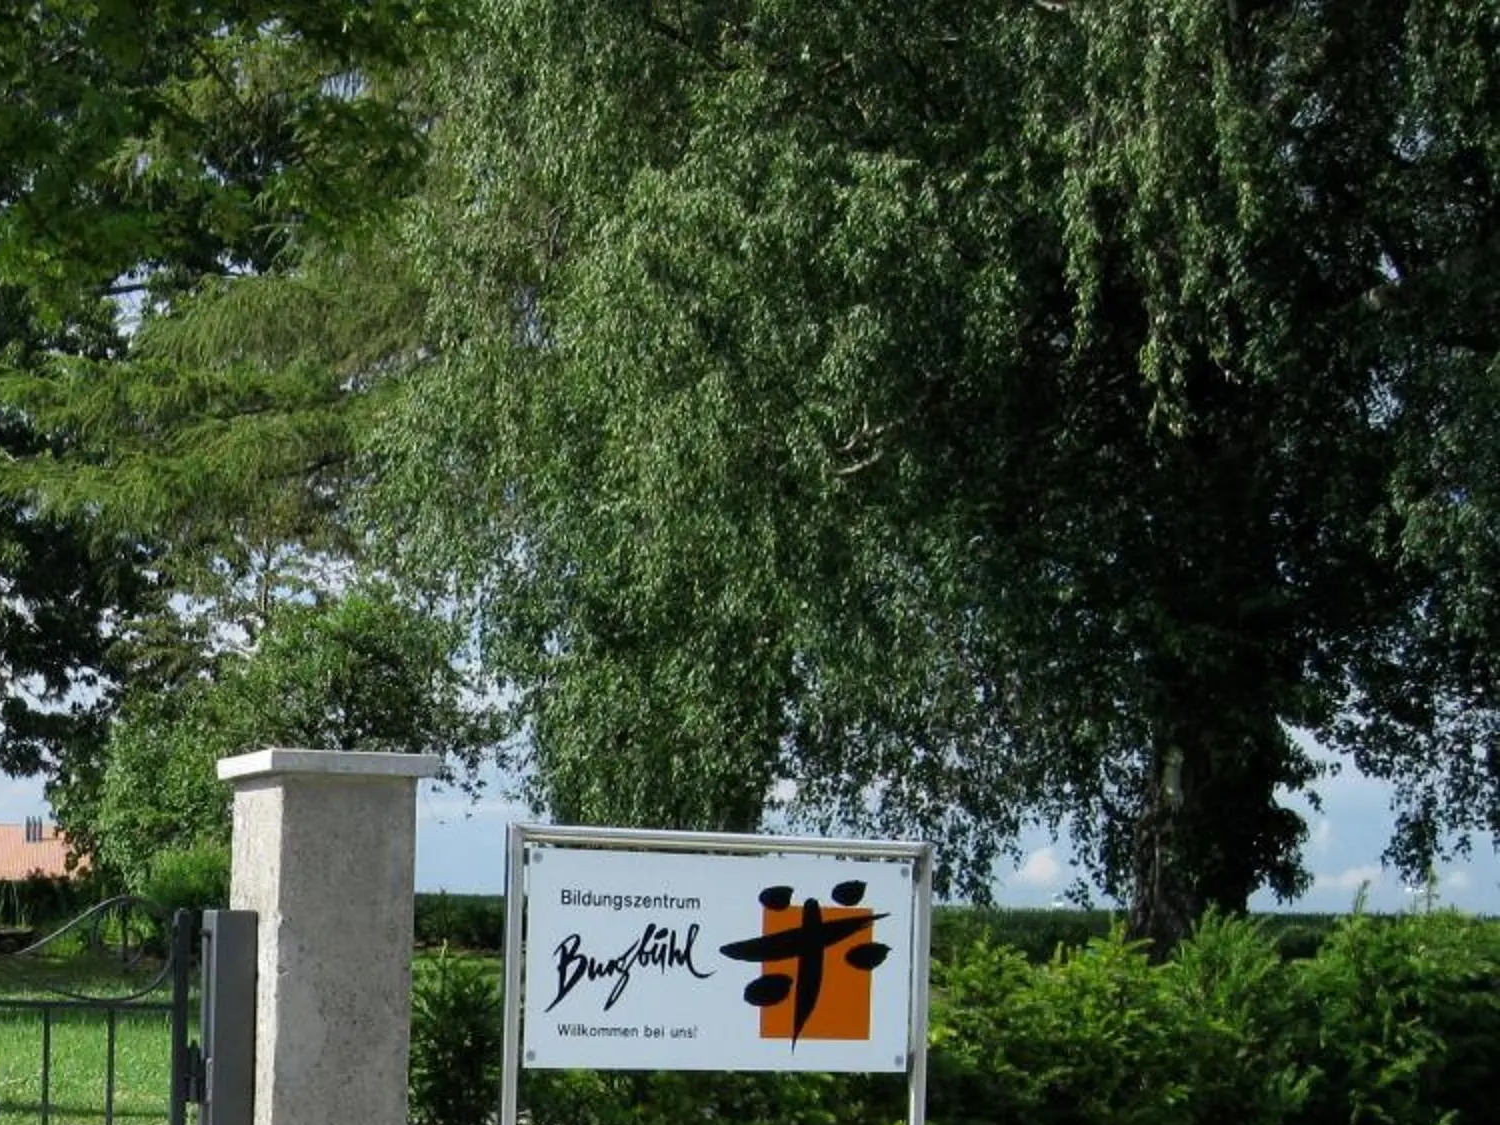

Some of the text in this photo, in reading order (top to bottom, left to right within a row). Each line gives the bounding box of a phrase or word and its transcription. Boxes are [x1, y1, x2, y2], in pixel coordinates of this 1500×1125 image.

[560, 888, 701, 911] Bildungszentrum
[557, 1023, 698, 1040] Willkommen bei uns!
